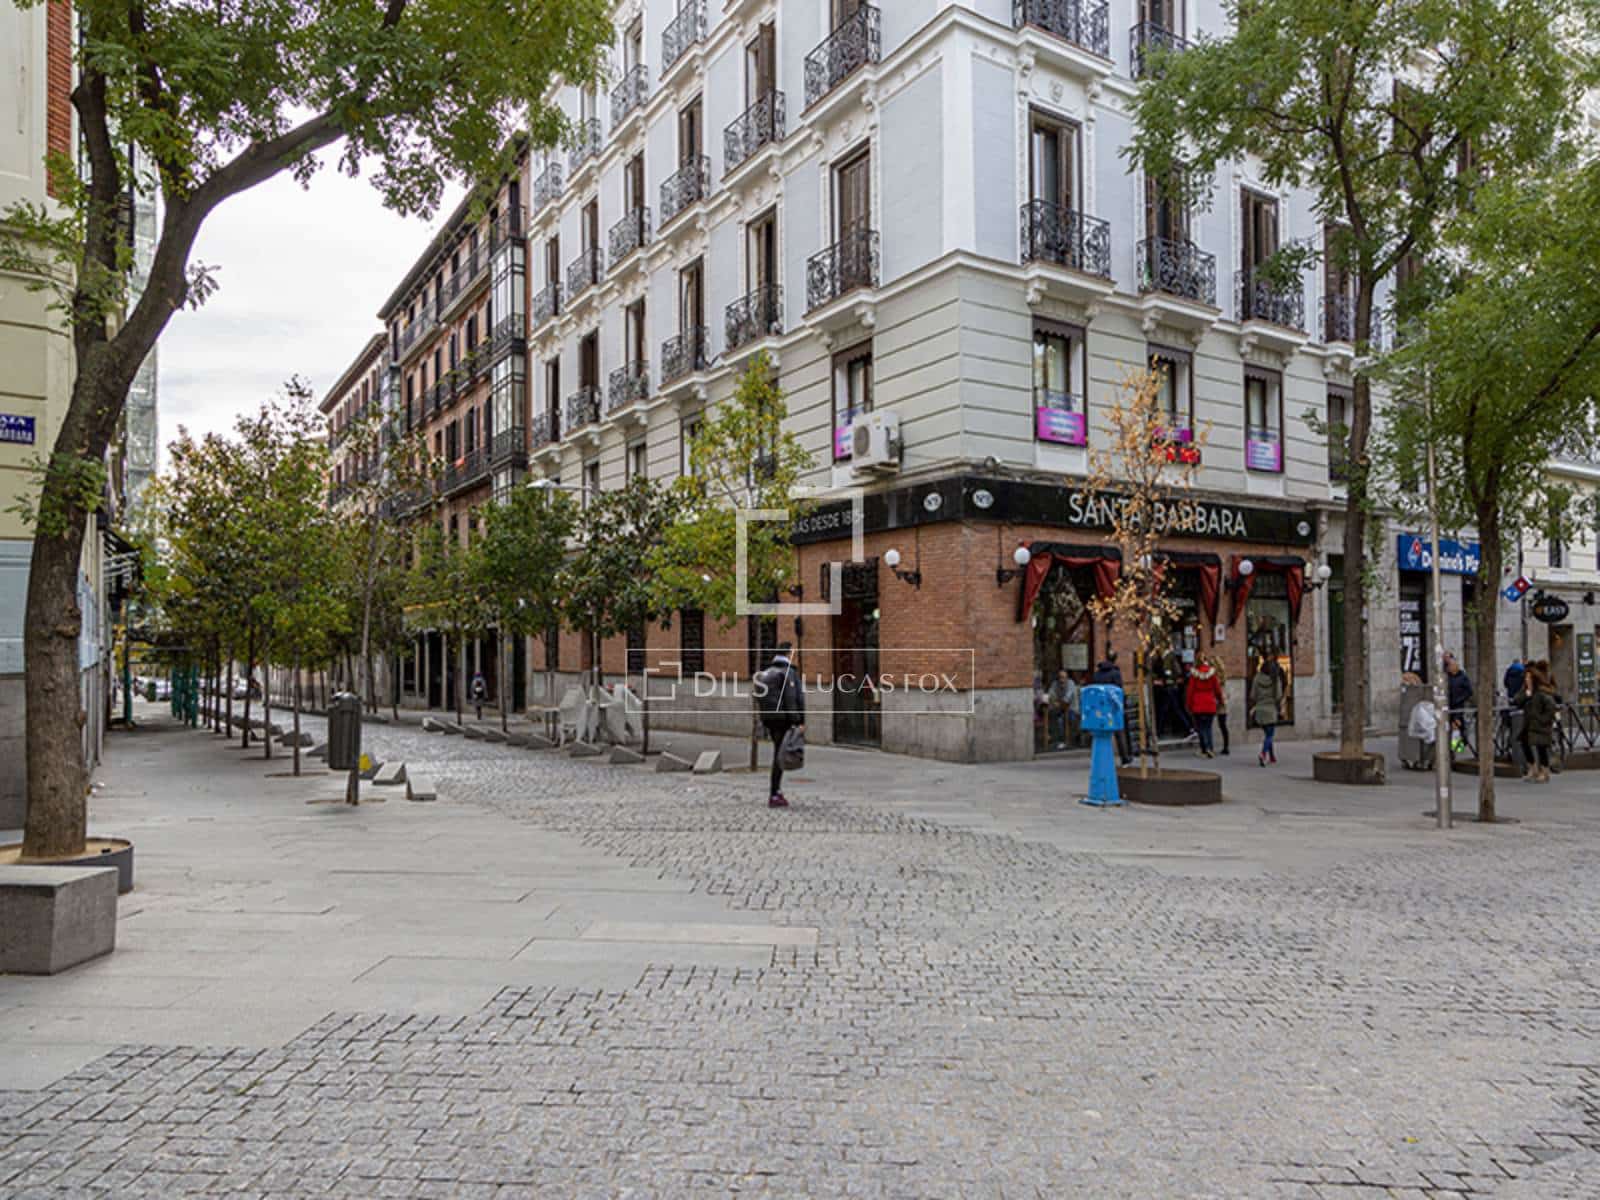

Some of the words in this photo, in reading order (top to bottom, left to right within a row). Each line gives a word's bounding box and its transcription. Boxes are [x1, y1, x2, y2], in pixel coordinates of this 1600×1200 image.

[810, 511, 840, 533] DESDE
[1068, 493, 1143, 530] SANTA
[1152, 502, 1248, 537] BARBARA
[1421, 550, 1463, 571] Dmino's
